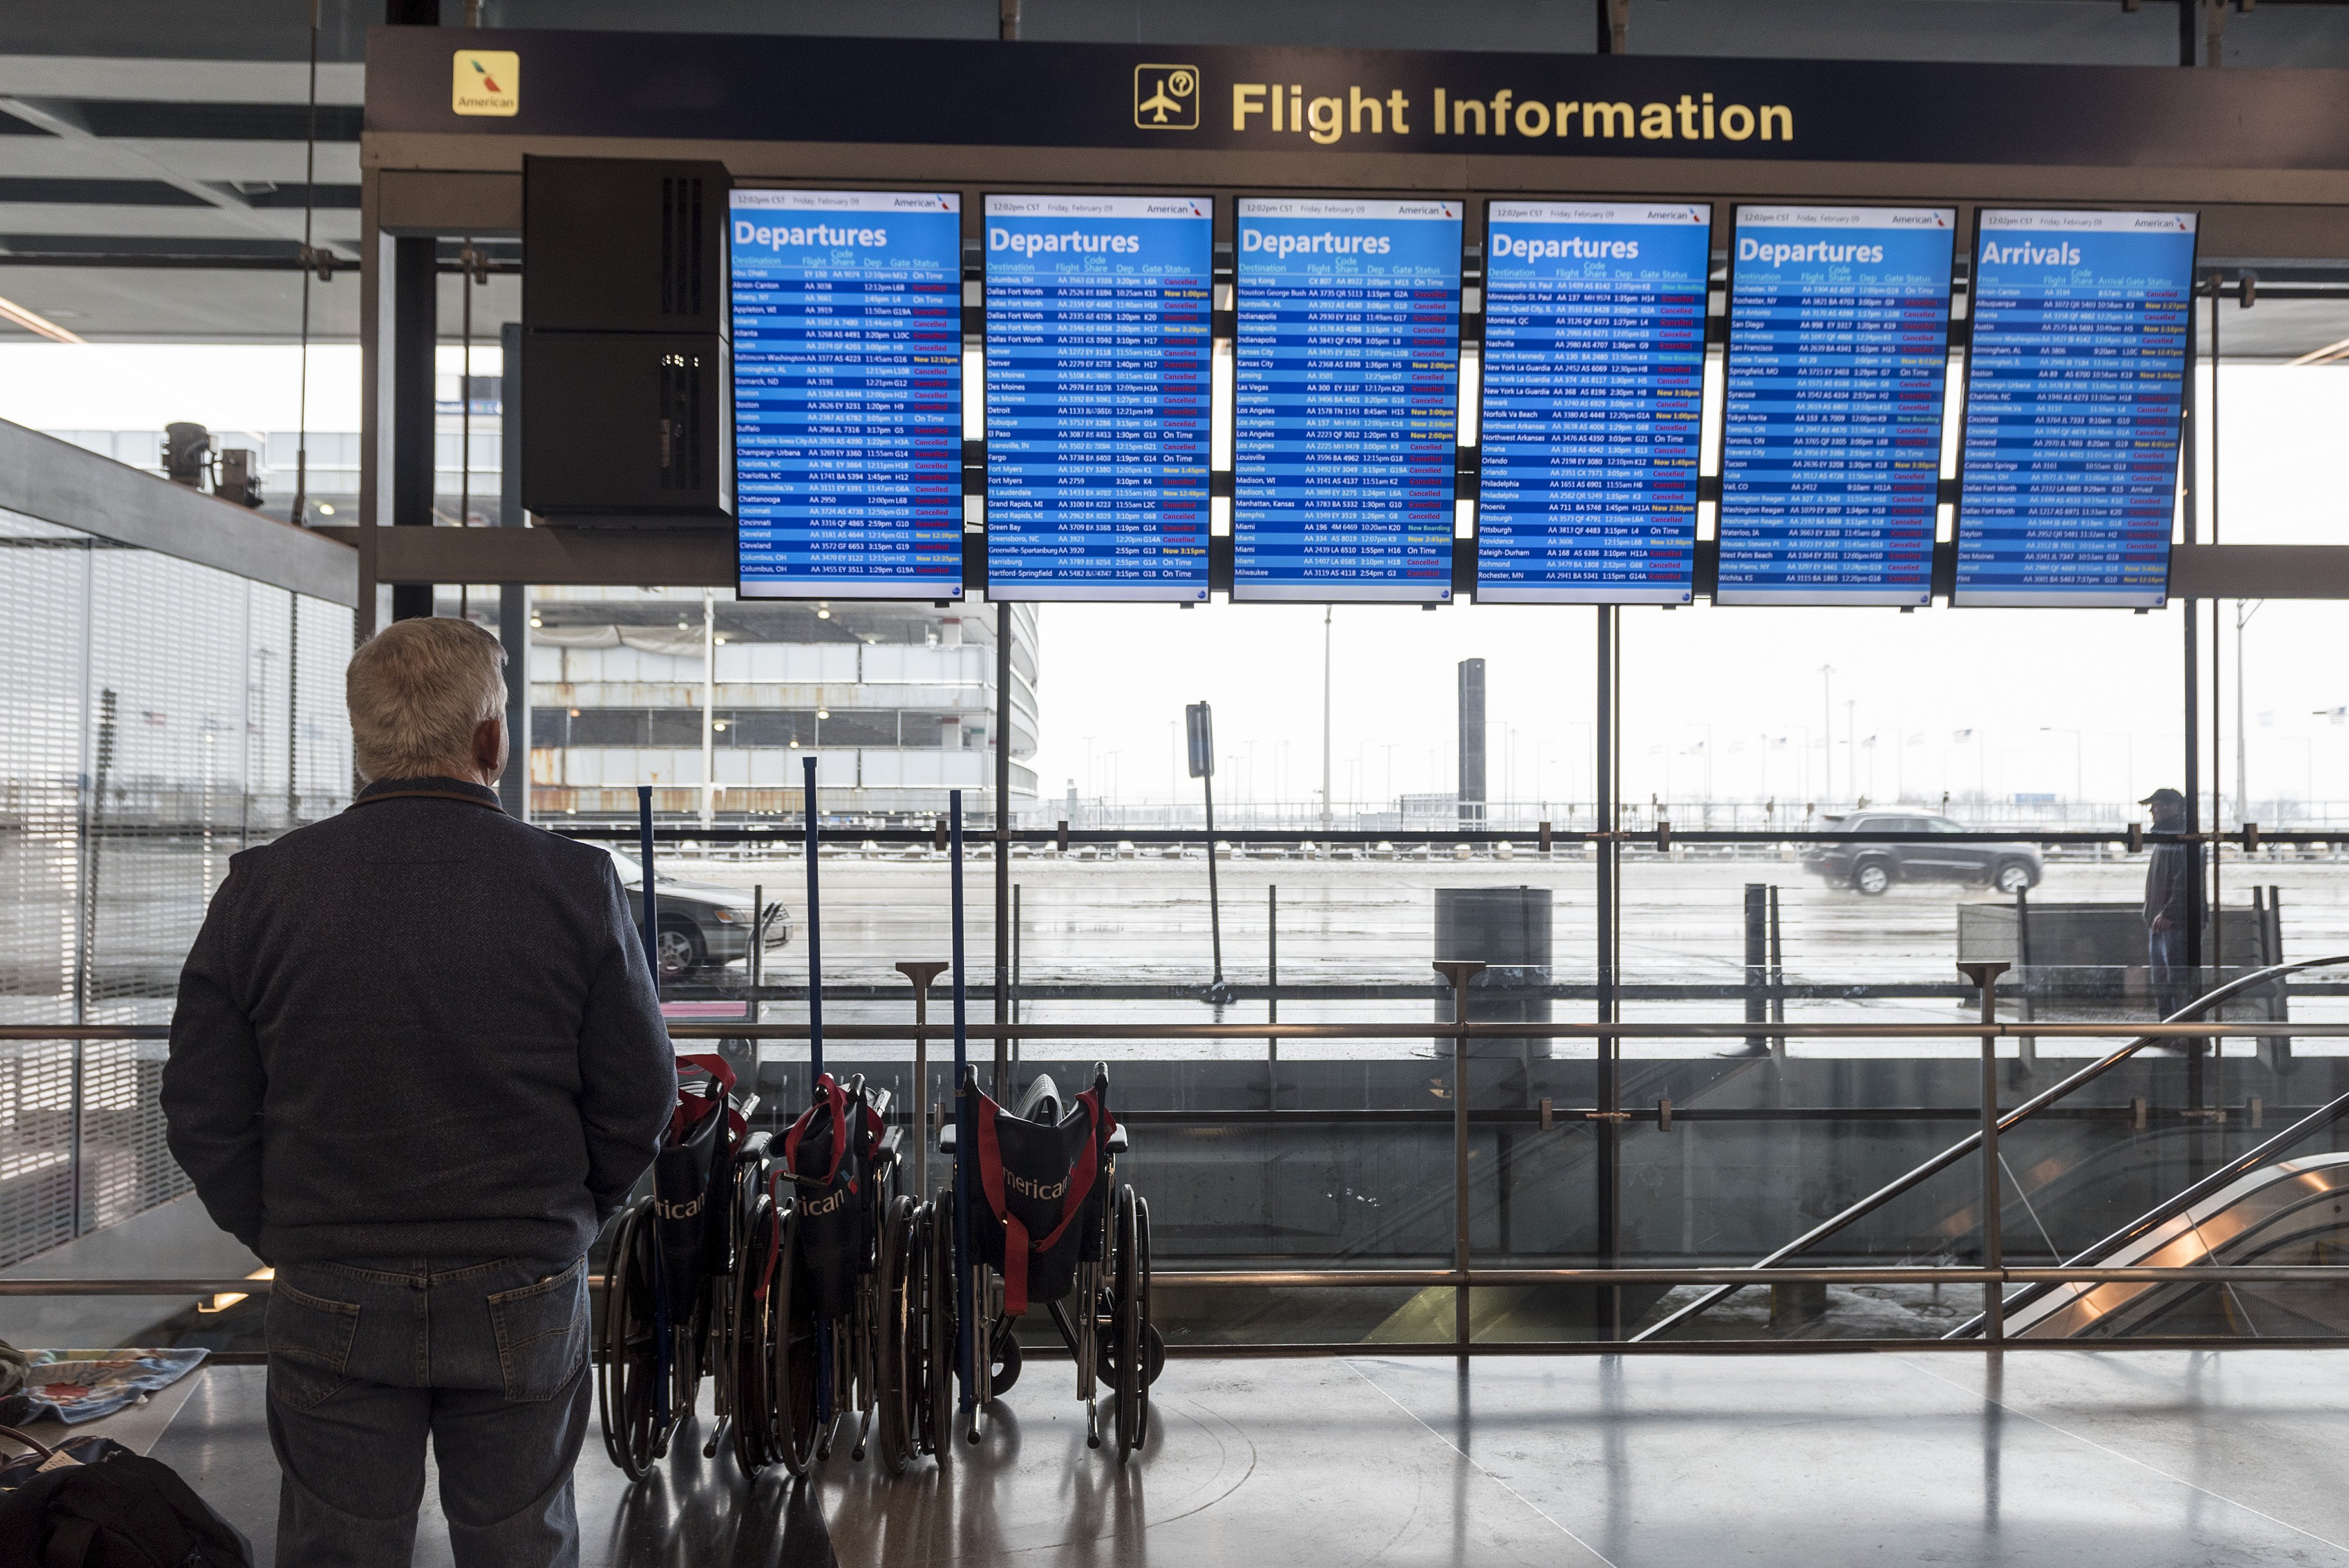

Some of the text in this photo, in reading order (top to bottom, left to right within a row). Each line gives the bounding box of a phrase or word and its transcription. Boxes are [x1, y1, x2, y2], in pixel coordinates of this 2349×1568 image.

[458, 96, 513, 107] American
[1231, 83, 1793, 144] Flight Information
[894, 198, 935, 207] American
[1648, 211, 1687, 219] American
[1892, 215, 1931, 223] American
[2135, 219, 2173, 227] American
[735, 221, 887, 251] Departures
[990, 228, 1139, 257] Departures
[1243, 230, 1390, 258] Departures
[1493, 234, 1638, 263] Departures
[1739, 238, 1883, 267] Departures
[1981, 241, 2081, 265] Arrivals
[1084, 256, 1106, 264] Code
[1335, 257, 1357, 265] Code
[1056, 264, 1079, 273] Flight
[1116, 265, 1134, 274] Dep
[1307, 265, 1331, 274] Flight
[1367, 265, 1384, 275] Dep
